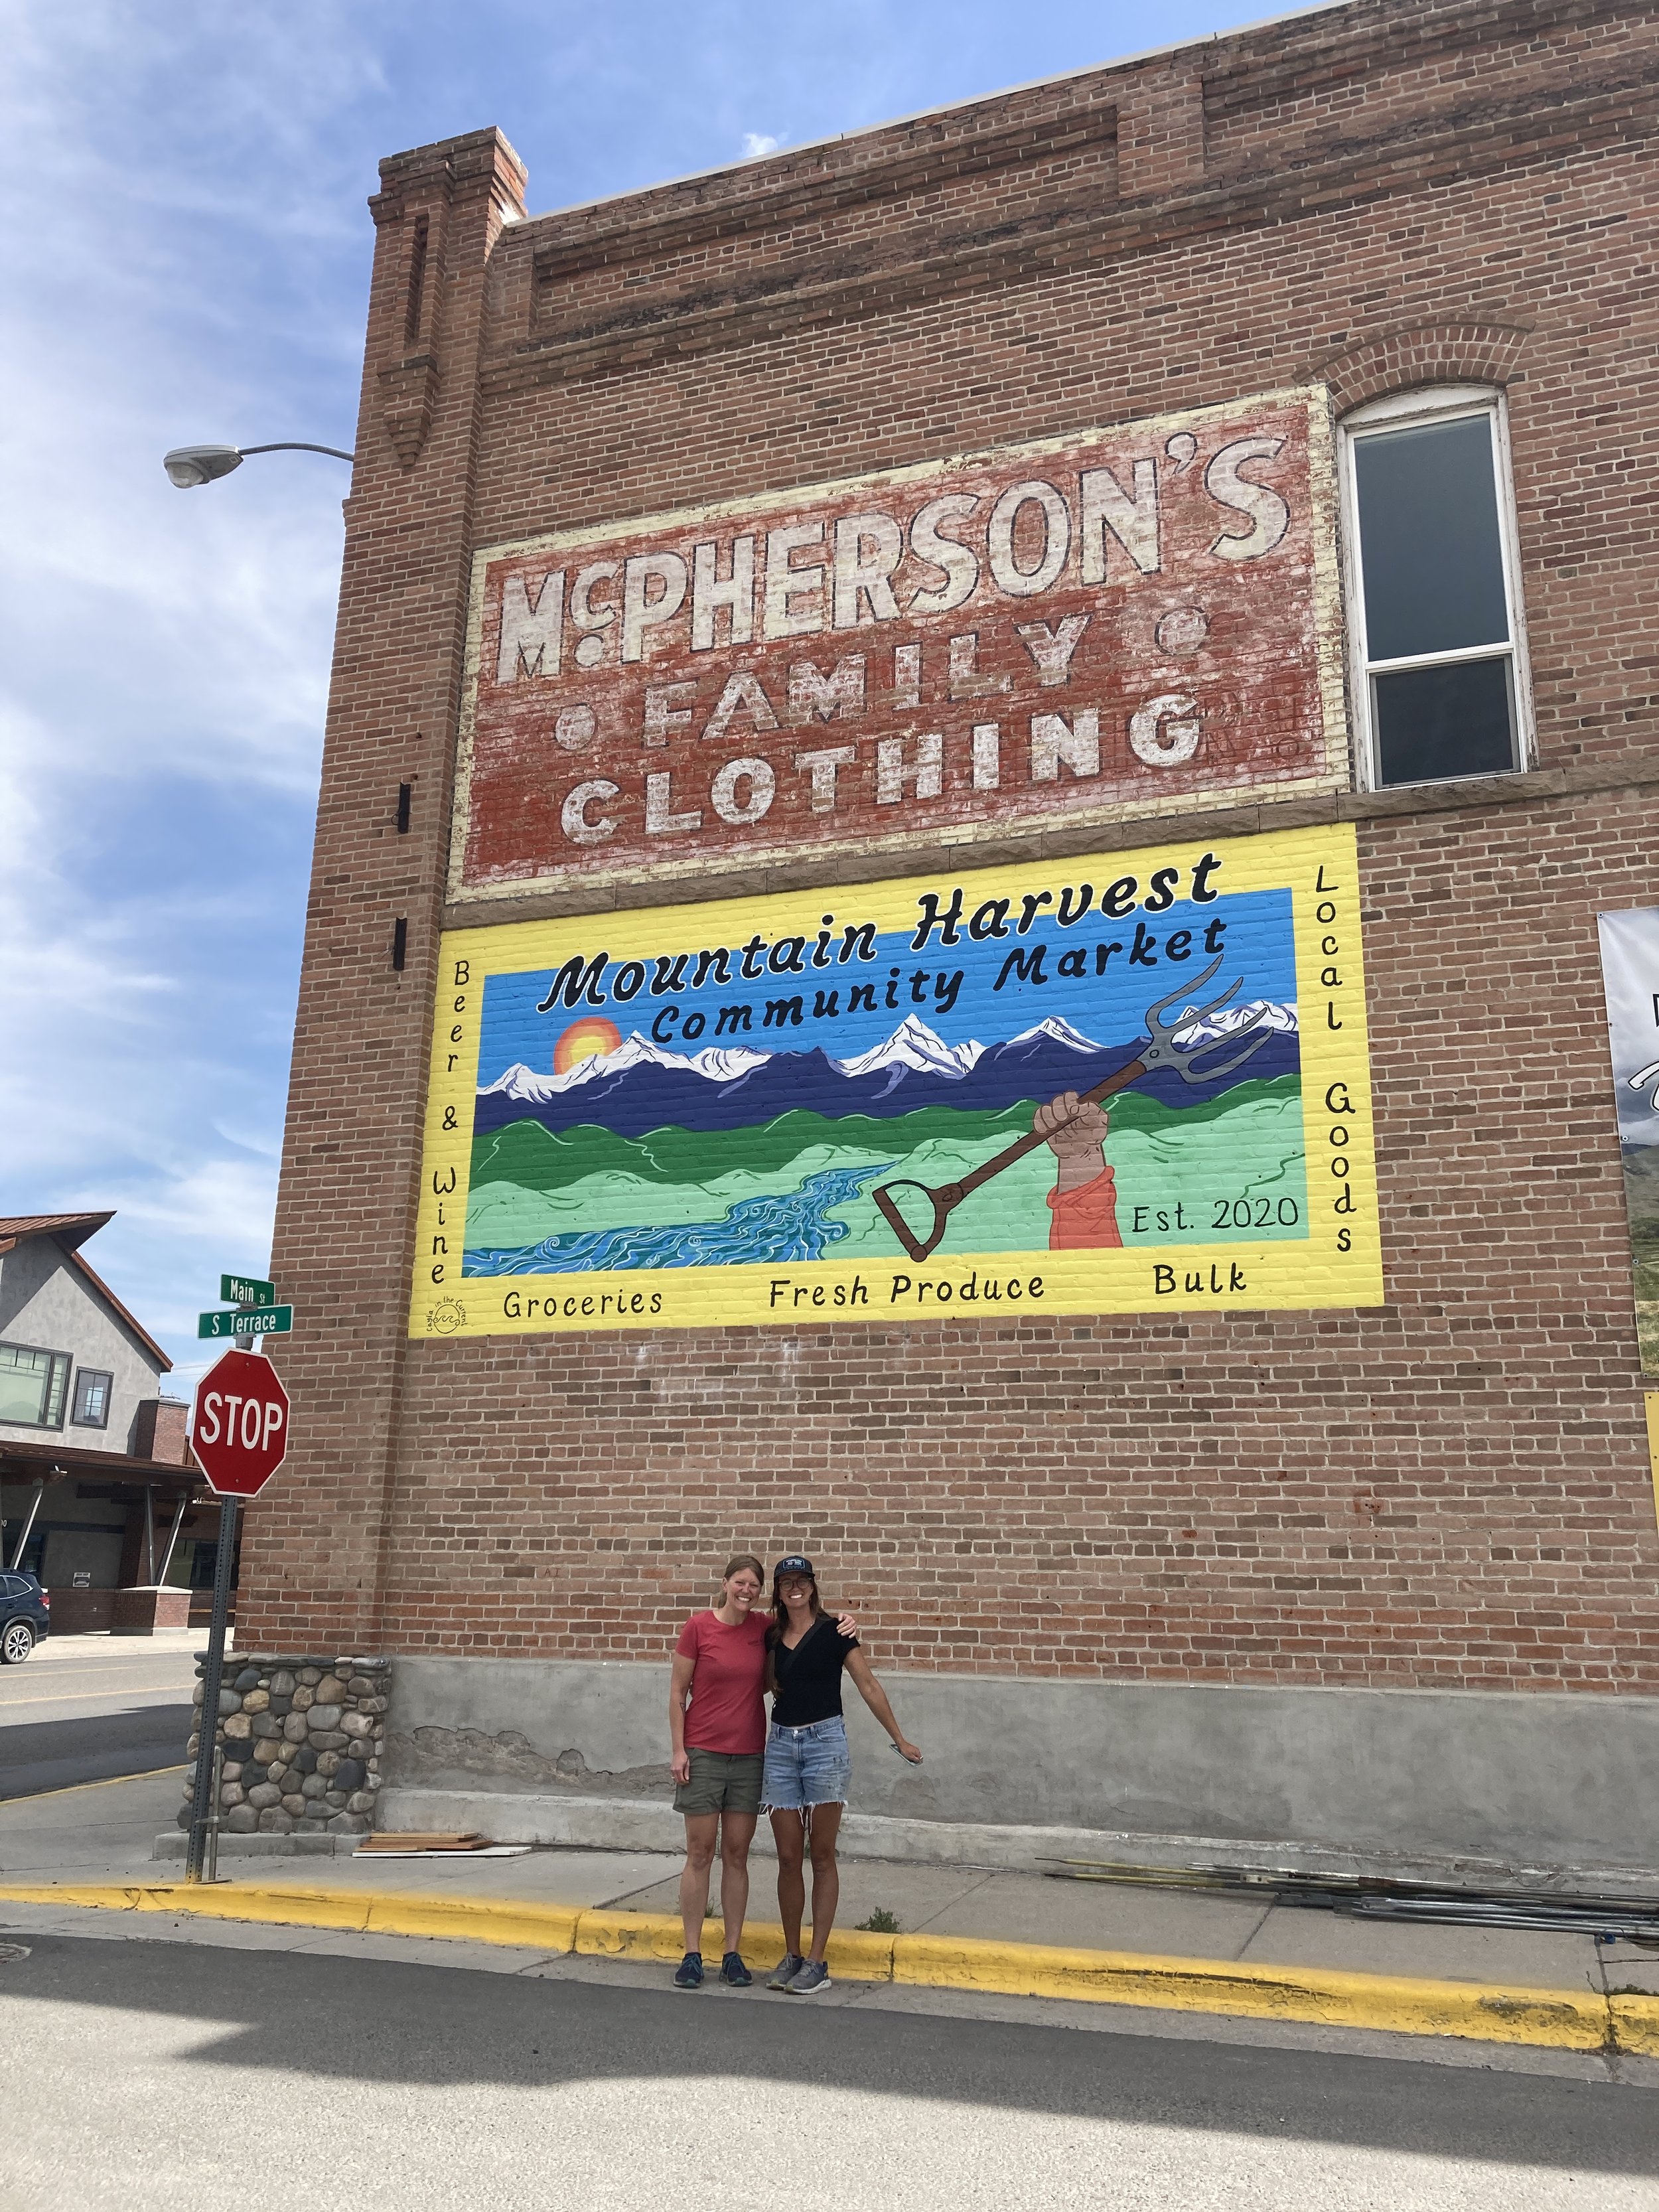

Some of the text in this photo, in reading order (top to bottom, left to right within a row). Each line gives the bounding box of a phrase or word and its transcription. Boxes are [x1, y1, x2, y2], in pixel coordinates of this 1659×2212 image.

[643, 613, 1093, 748] FAMILY
[561, 694, 1200, 845] CLOTHING
[537, 852, 1222, 1013] Mountain Harvest
[652, 919, 1227, 1043] Community Market
[1316, 865, 1357, 1252] Local Goods
[431, 960, 470, 1284] Beer & Wine
[1131, 1197, 1299, 1233] Est. 2020
[230, 1278, 265, 1305] Main St
[504, 1290, 663, 1318] Groceries
[770, 1271, 1045, 1307] Fresh Produce
[1153, 1263, 1248, 1294] Bulk
[211, 1312, 277, 1335] S Terrace
[200, 1391, 283, 1451] STOP
